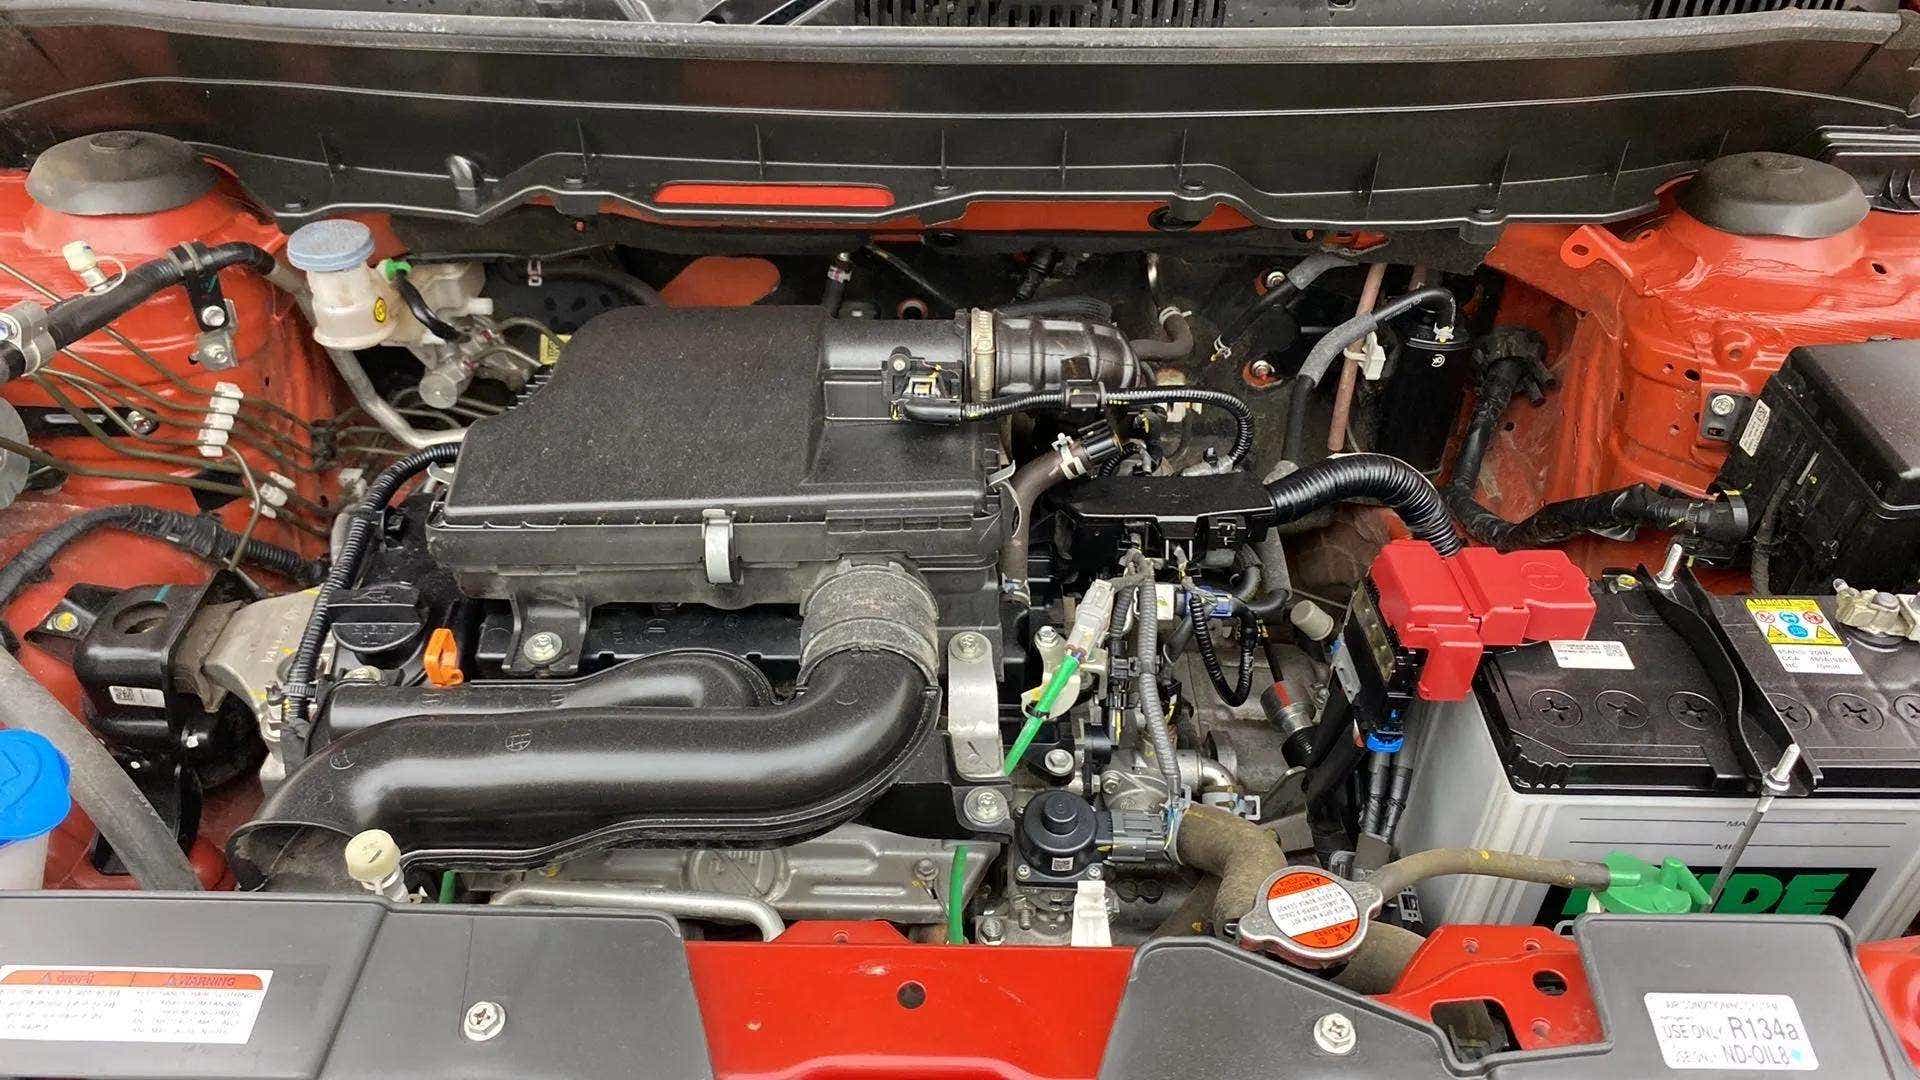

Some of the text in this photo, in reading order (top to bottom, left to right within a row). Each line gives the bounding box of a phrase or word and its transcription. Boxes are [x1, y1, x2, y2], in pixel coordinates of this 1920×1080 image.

[180, 976, 236, 988] WARNING
[1663, 1024, 1690, 1039] USE
[1727, 1016, 1800, 1040] R134a
[1721, 1044, 1790, 1064] ND-OIL8
